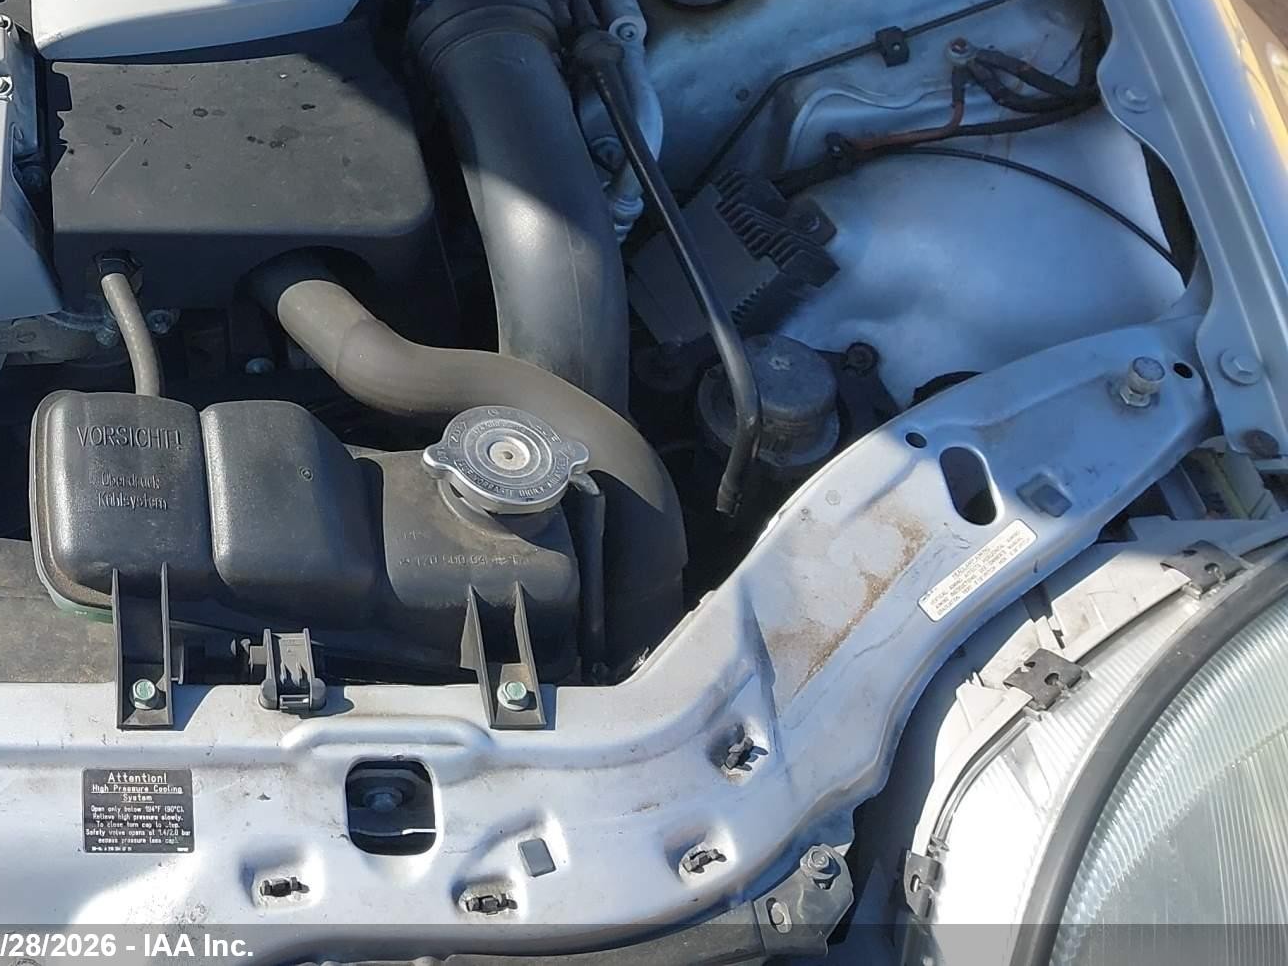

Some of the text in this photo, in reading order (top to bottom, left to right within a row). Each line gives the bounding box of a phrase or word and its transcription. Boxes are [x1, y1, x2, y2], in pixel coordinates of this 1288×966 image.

[107, 771, 167, 784] Attention!
[92, 783, 184, 793] High Pressure Cooling
[122, 793, 153, 803] System
